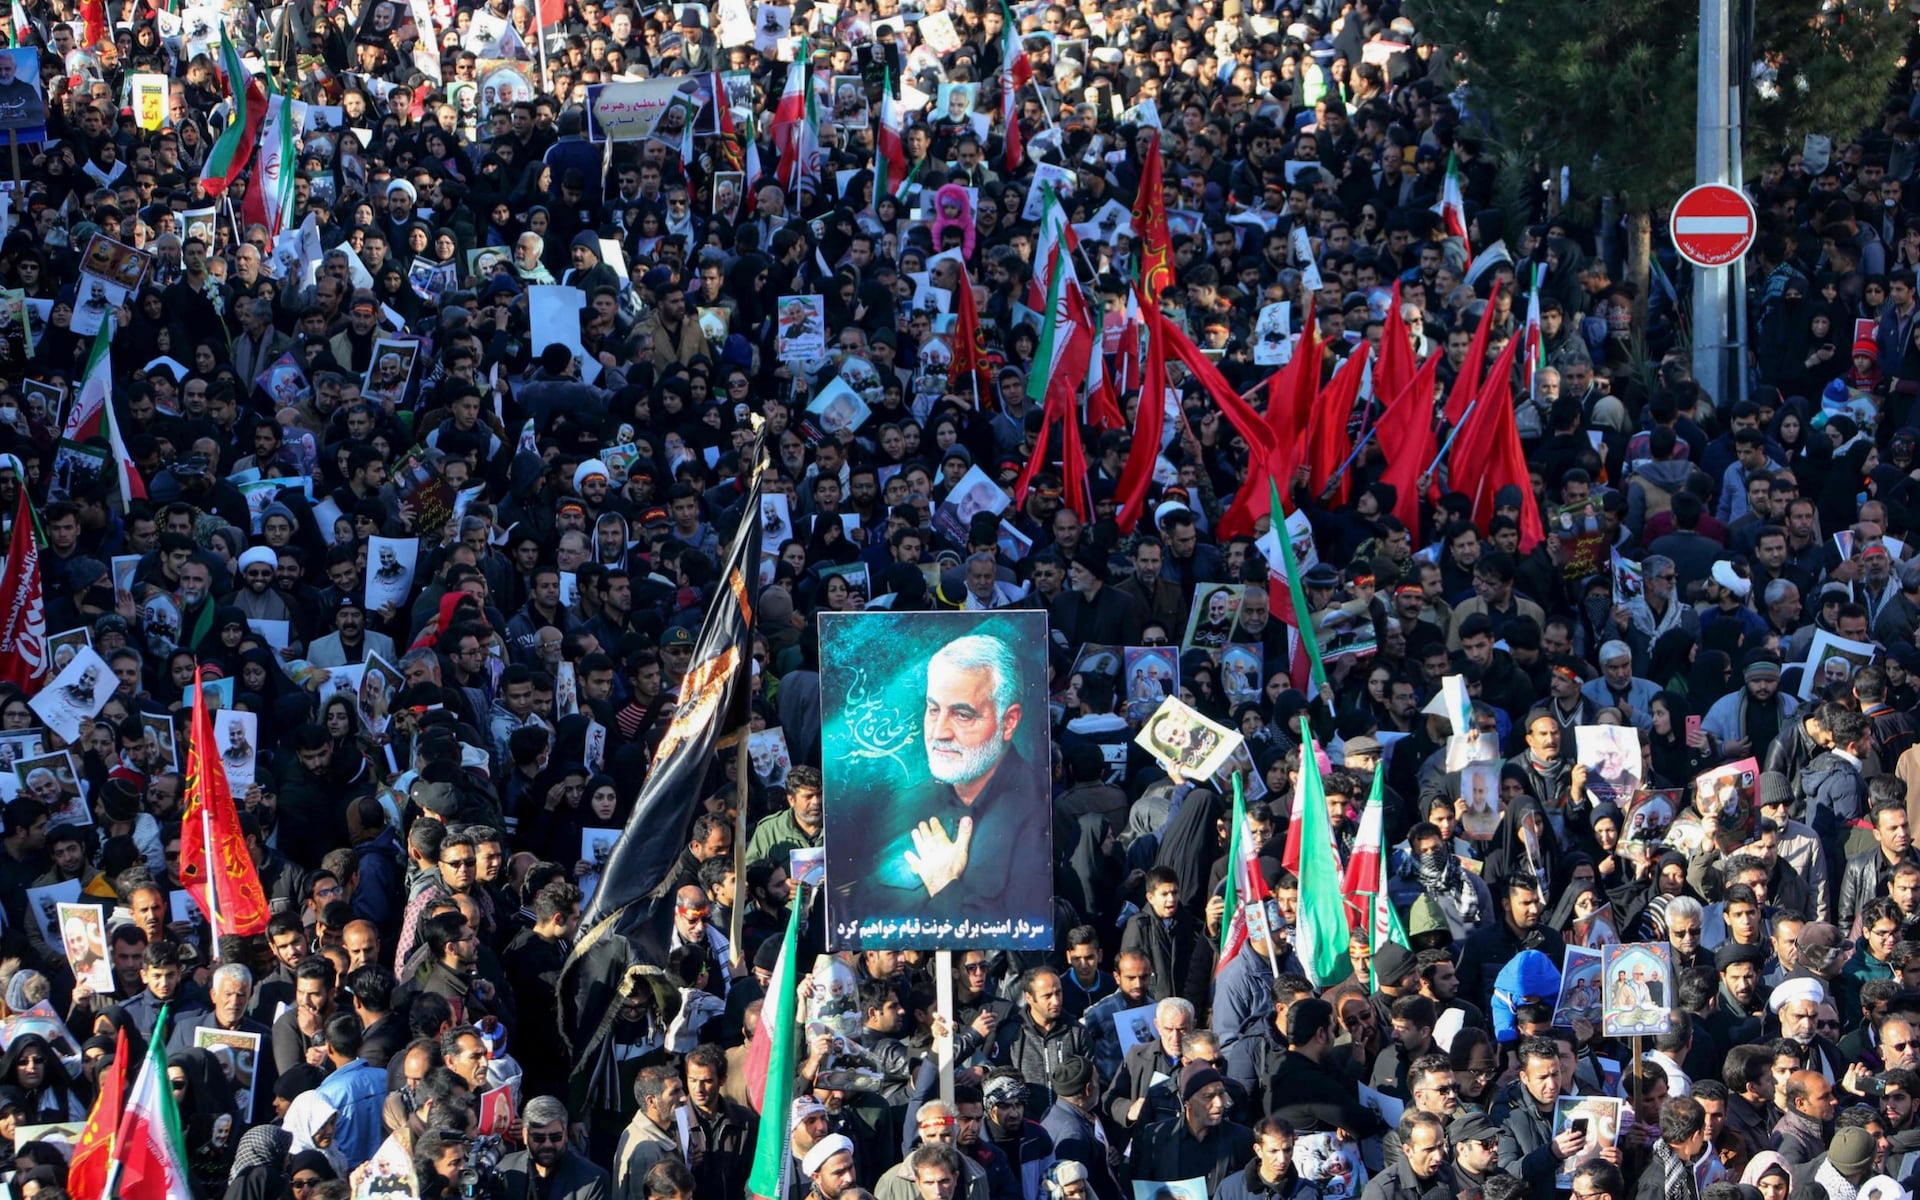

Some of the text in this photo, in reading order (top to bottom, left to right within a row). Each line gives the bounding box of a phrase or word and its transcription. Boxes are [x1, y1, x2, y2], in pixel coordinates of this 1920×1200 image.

[836, 917, 1045, 939] سردار امنیت برای خونت قیام خواهیم کرد
